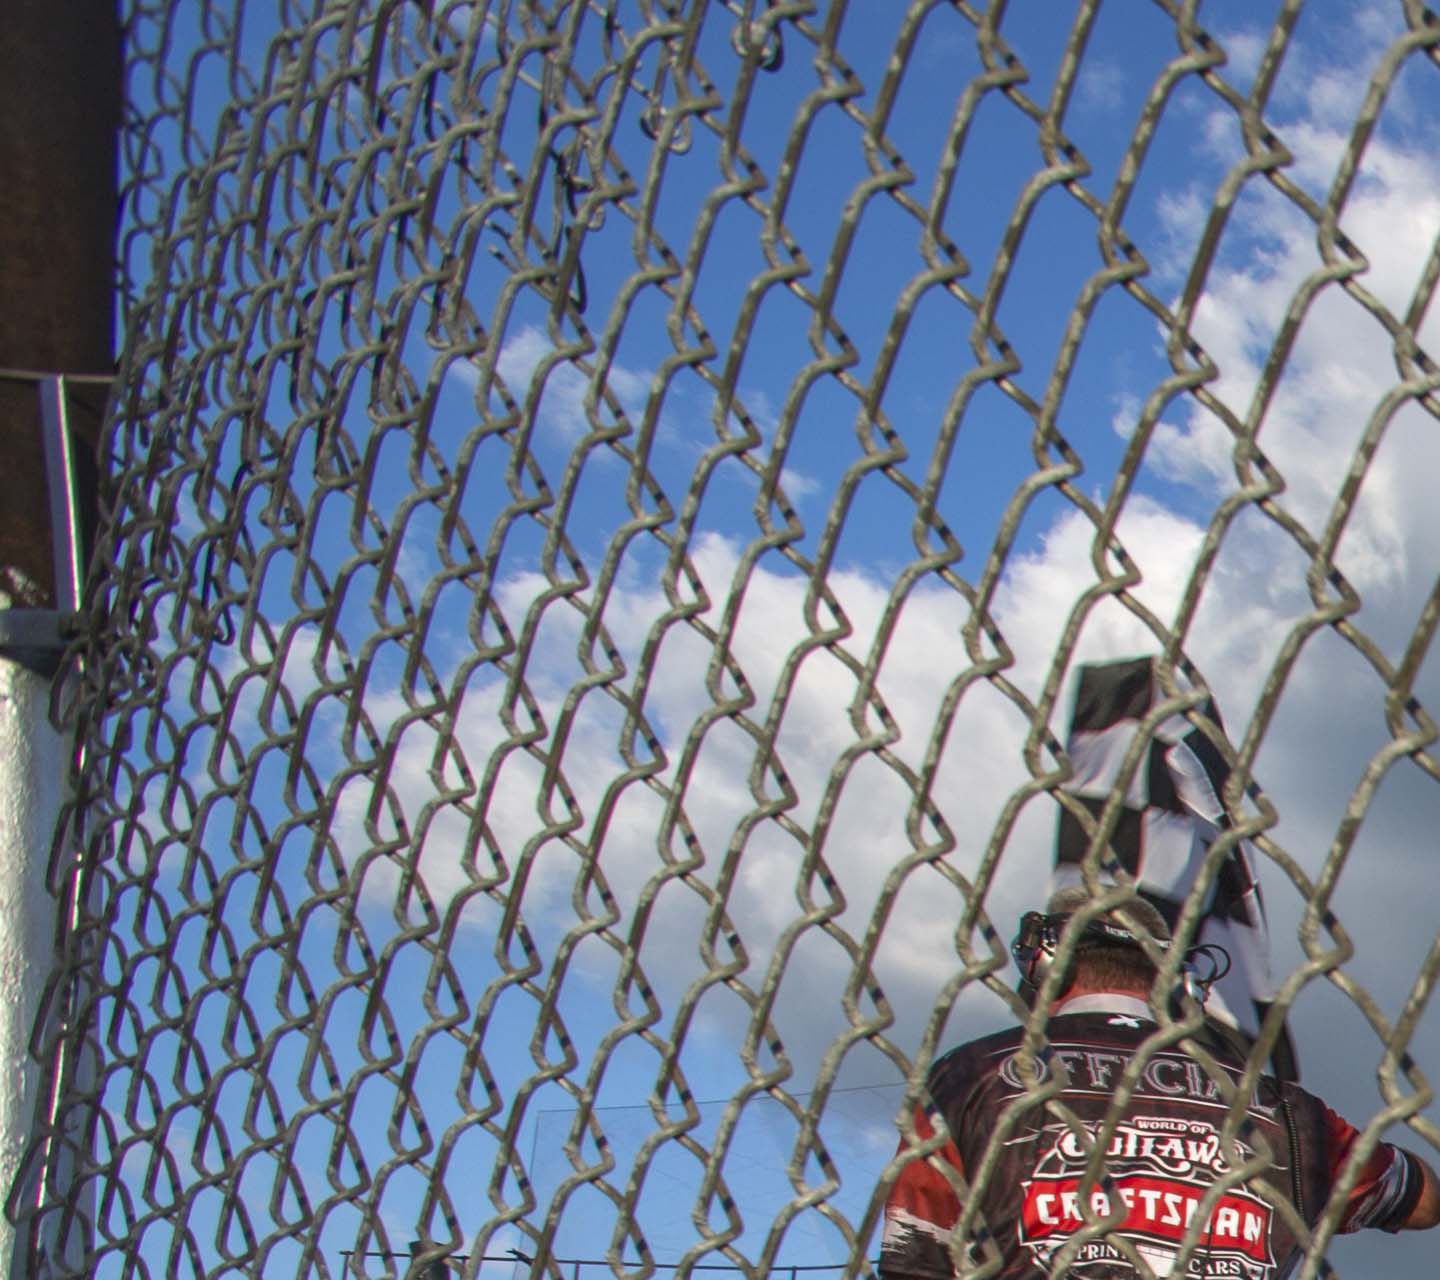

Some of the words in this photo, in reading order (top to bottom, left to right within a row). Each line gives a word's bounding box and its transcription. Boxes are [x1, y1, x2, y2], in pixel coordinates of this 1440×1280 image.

[998, 1050, 1277, 1117] OFFCIL
[1137, 1119, 1187, 1132] WORLD
[1191, 1124, 1210, 1135] OF
